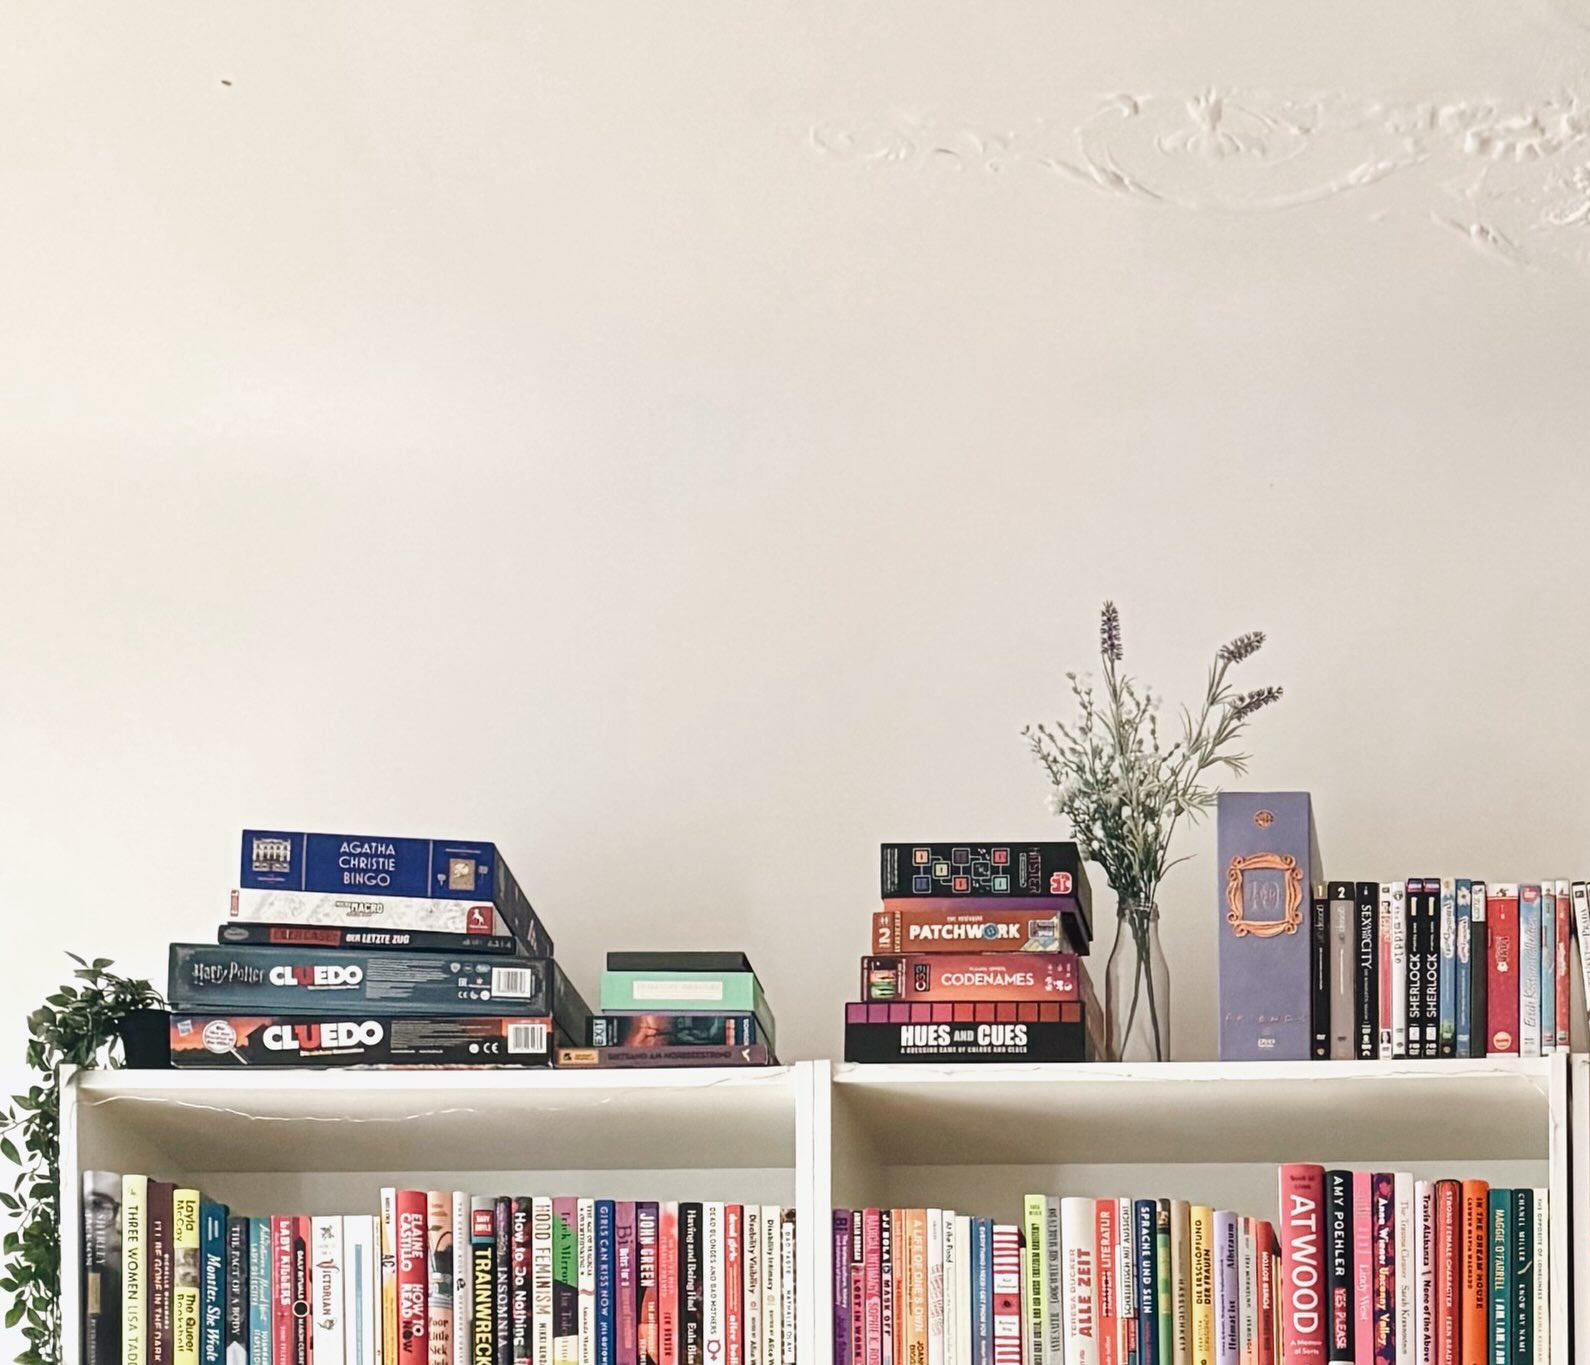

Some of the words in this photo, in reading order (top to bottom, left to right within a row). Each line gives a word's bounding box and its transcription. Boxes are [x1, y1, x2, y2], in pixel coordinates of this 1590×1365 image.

[339, 841, 396, 856] AGATHA
[338, 856, 396, 871] CHRISTIE
[343, 873, 391, 886] BINGO
[910, 923, 1020, 940] PATCHWORK
[192, 963, 228, 985] Harry
[229, 962, 263, 982] Potter
[269, 965, 363, 986] CLUEDO
[941, 973, 1034, 986] CODENAMES
[1409, 954, 1419, 1017] SHERLOCK
[1426, 954, 1436, 1017] SHERLOCK
[263, 1021, 383, 1050] CLUEDO
[901, 1025, 950, 1046] HUES
[953, 1031, 974, 1041] AND
[977, 1024, 1027, 1045] CUES
[1334, 1176, 1344, 1205] AMY
[128, 1206, 138, 1242] THREE
[640, 1213, 654, 1245] JOHN
[1334, 1212, 1344, 1275] POEHLER
[128, 1248, 138, 1300] WOMEN
[640, 1249, 654, 1287] GREEN
[1290, 1194, 1318, 1333] ATWOOD
